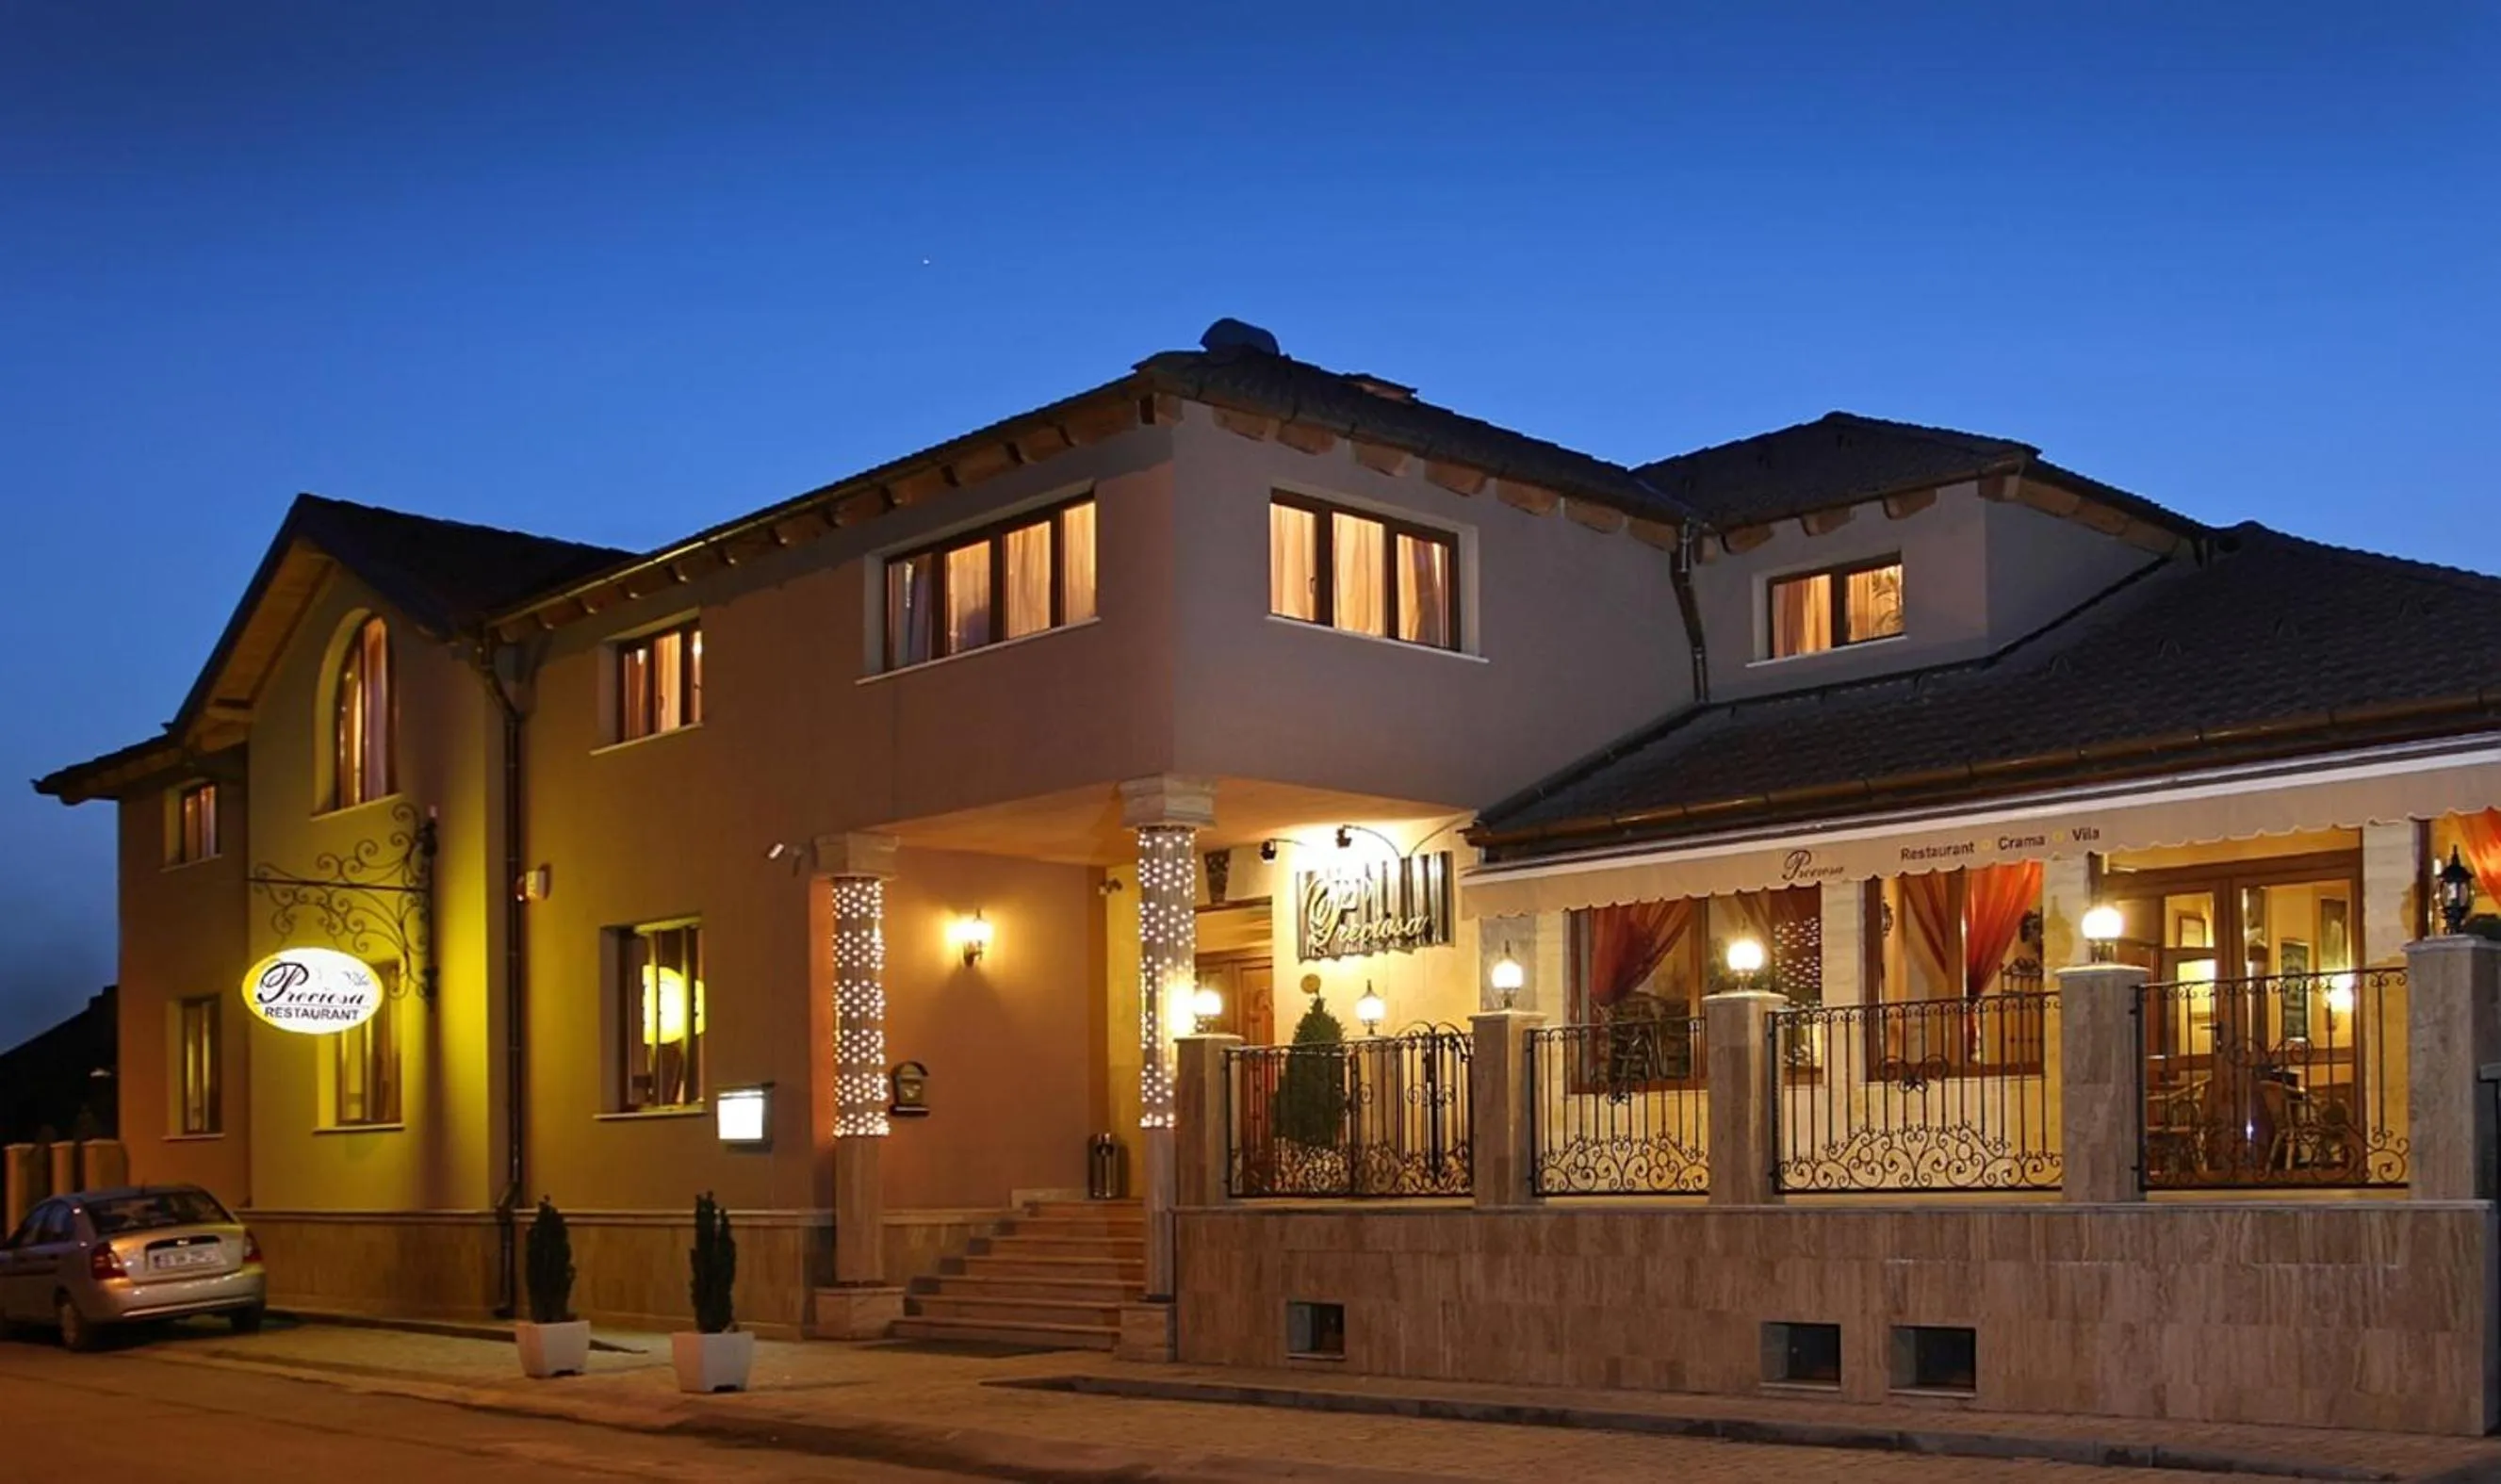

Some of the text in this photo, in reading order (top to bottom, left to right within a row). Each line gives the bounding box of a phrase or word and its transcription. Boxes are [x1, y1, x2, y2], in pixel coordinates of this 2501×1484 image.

[1901, 827, 2101, 860] Restaurant Crama Vila
[265, 1006, 360, 1020] RESTAURANT
